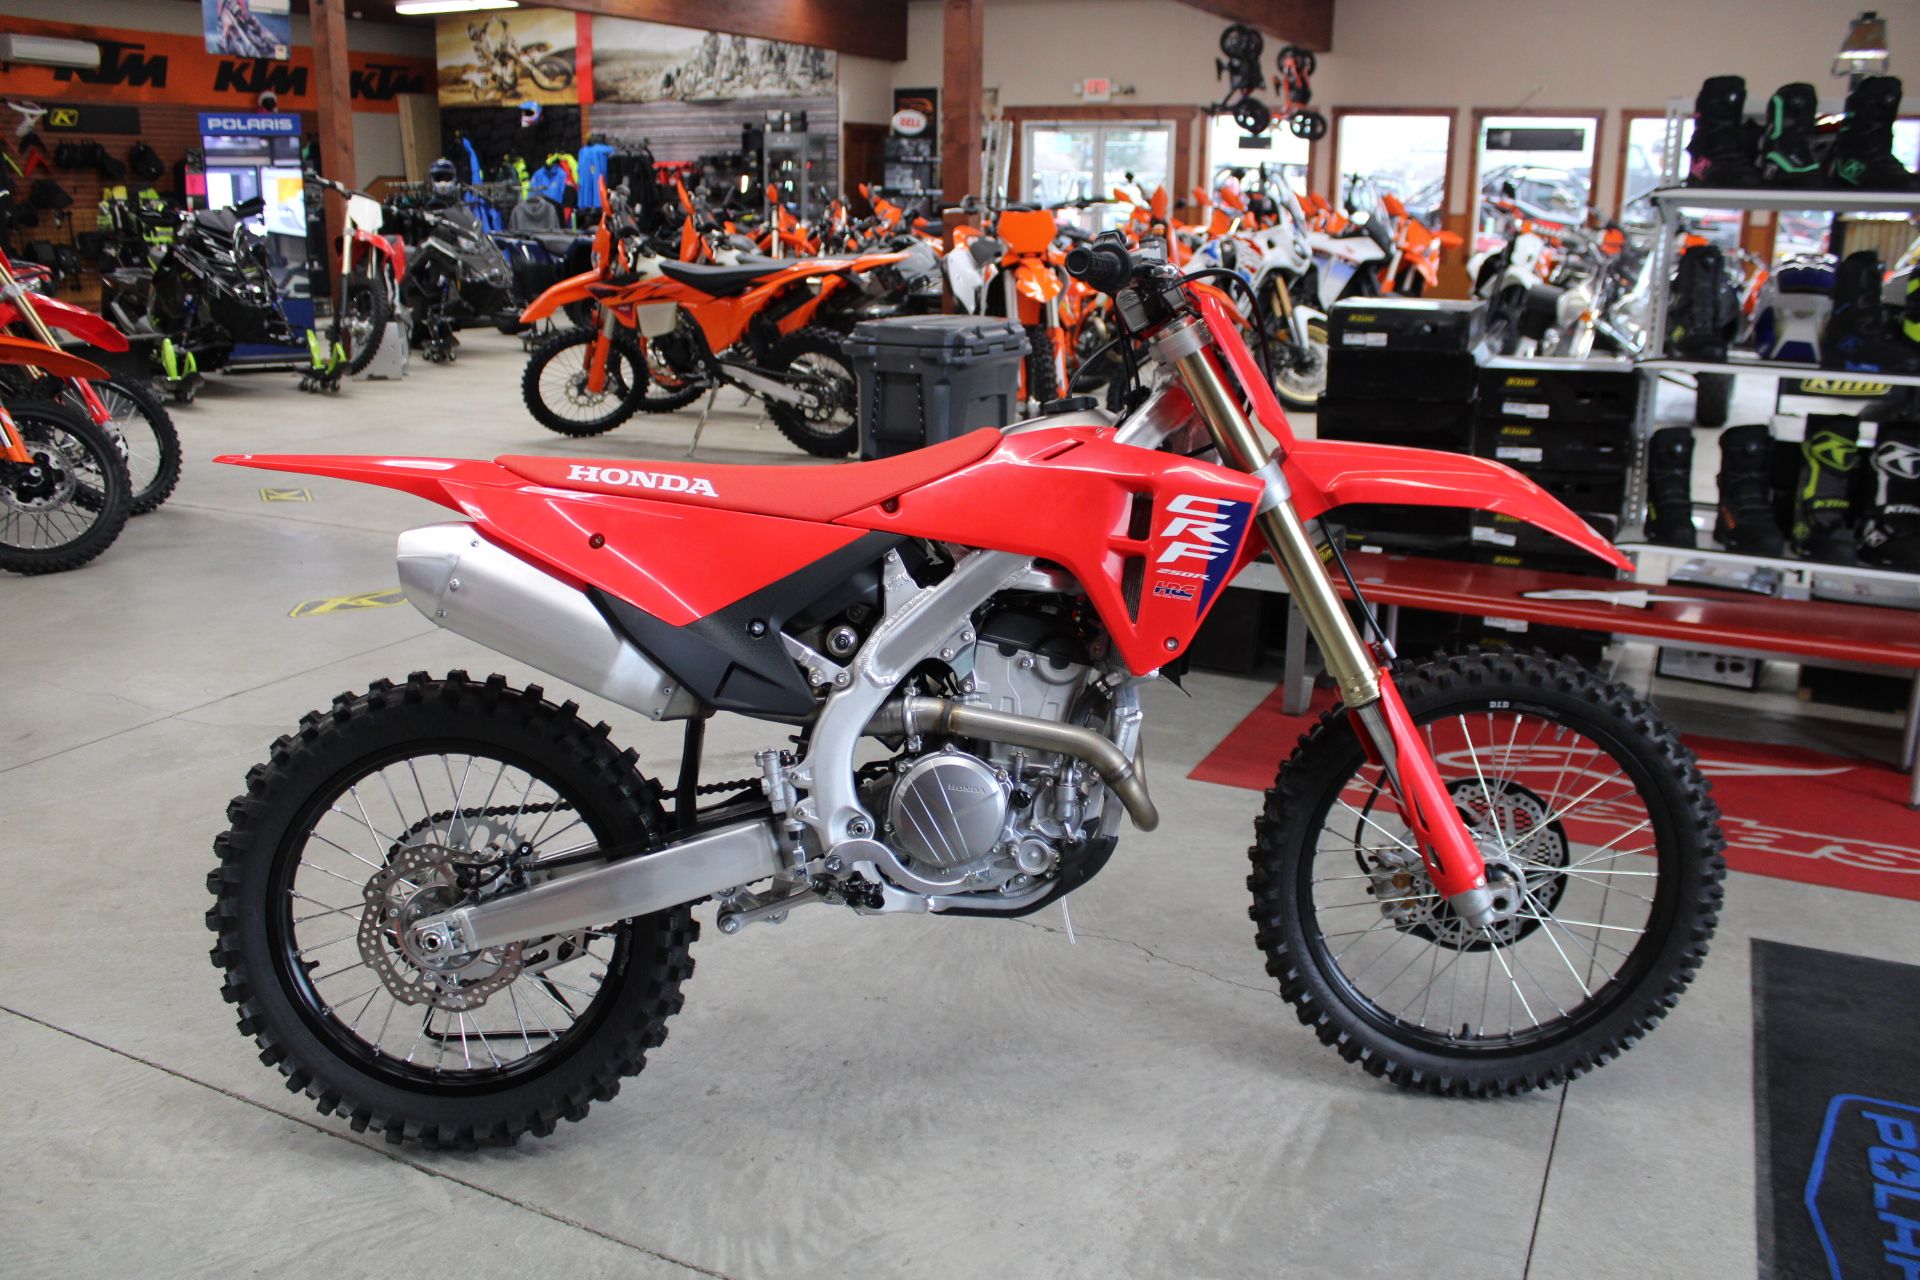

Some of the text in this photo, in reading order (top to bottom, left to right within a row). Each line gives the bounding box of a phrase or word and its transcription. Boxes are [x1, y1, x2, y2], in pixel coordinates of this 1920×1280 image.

[213, 56, 308, 97] KTM
[207, 117, 294, 131] POLARIS
[567, 464, 719, 497] HONDA
[1156, 494, 1237, 563] CRF
[1156, 568, 1211, 581] 250R
[1153, 581, 1197, 598] HRC
[948, 784, 987, 794] HONDA
